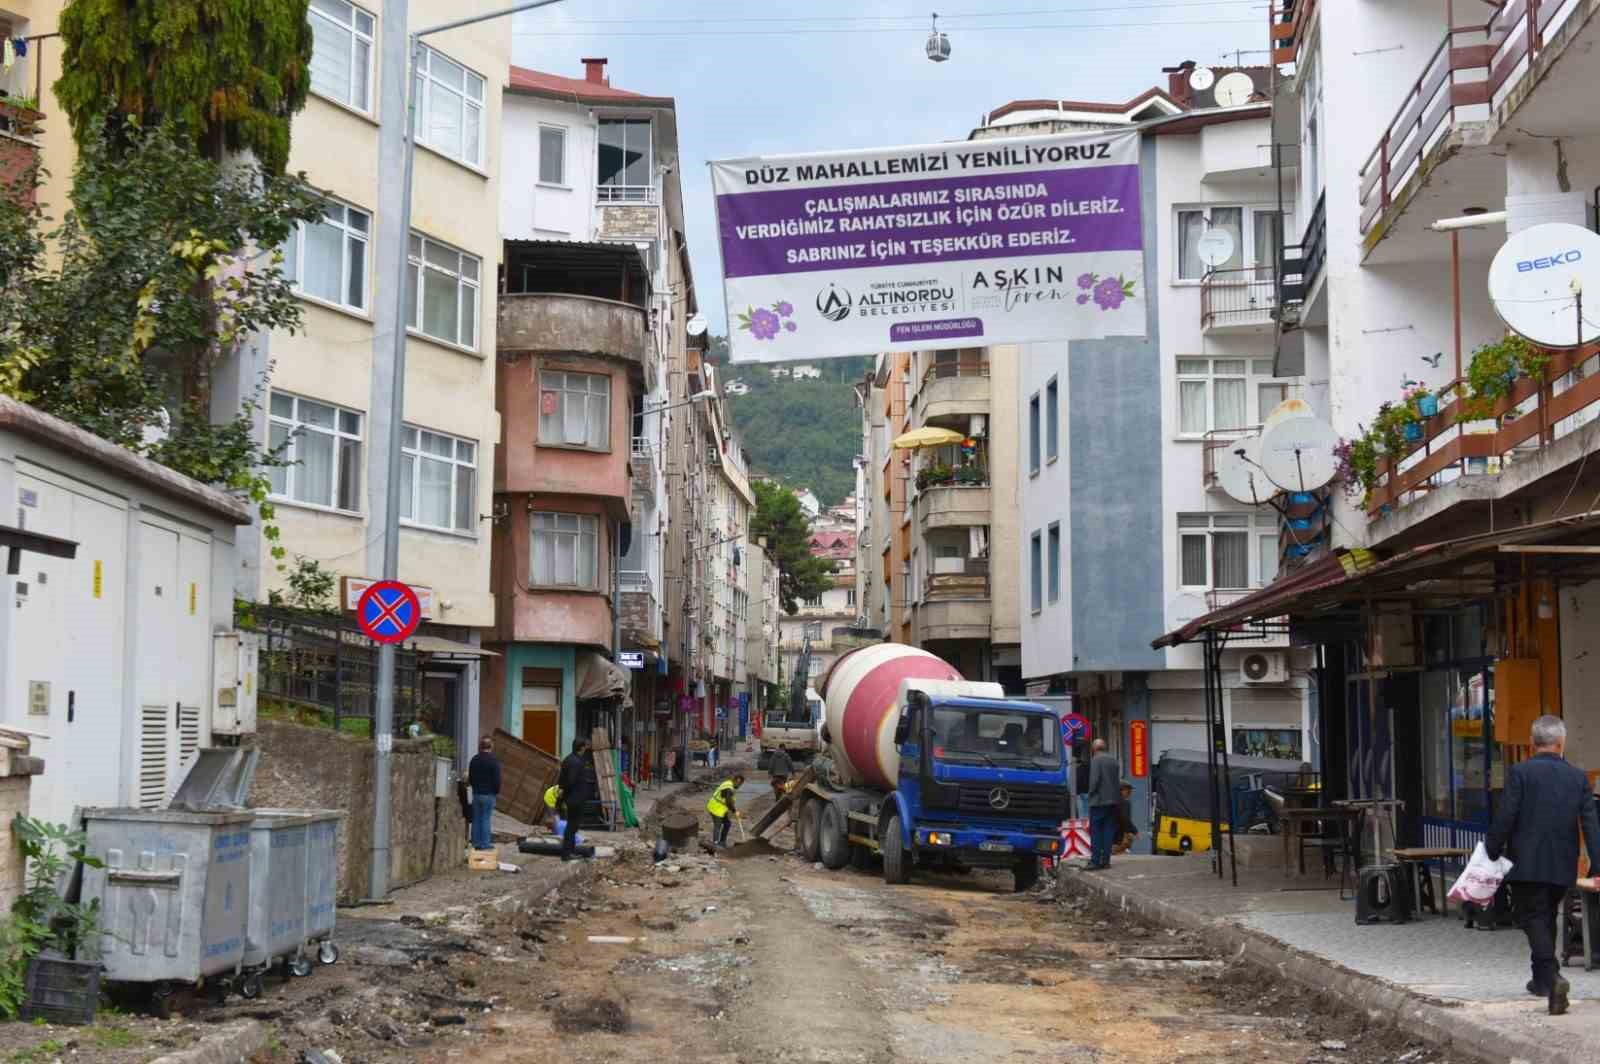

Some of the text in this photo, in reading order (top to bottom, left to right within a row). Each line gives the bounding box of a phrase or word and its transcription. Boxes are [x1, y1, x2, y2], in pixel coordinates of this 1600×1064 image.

[745, 143, 1111, 185] DÜZ MAHALLEMİZİ YENİLİYORUZ
[805, 183, 1048, 216] ÇALIŞMALARIMIZ SIRASINDA
[736, 196, 1124, 240] VERDİĞİMİZ RAHATSIZLIK İÇİN ÖZÜR DİLERİZ.
[786, 227, 1076, 264] SABRINIZ İÇİN TEŞEKKÜR EDERİZ.
[1516, 249, 1582, 273] BEKO
[972, 266, 1063, 290] AŞKIN
[858, 287, 954, 306] ALTINORDU
